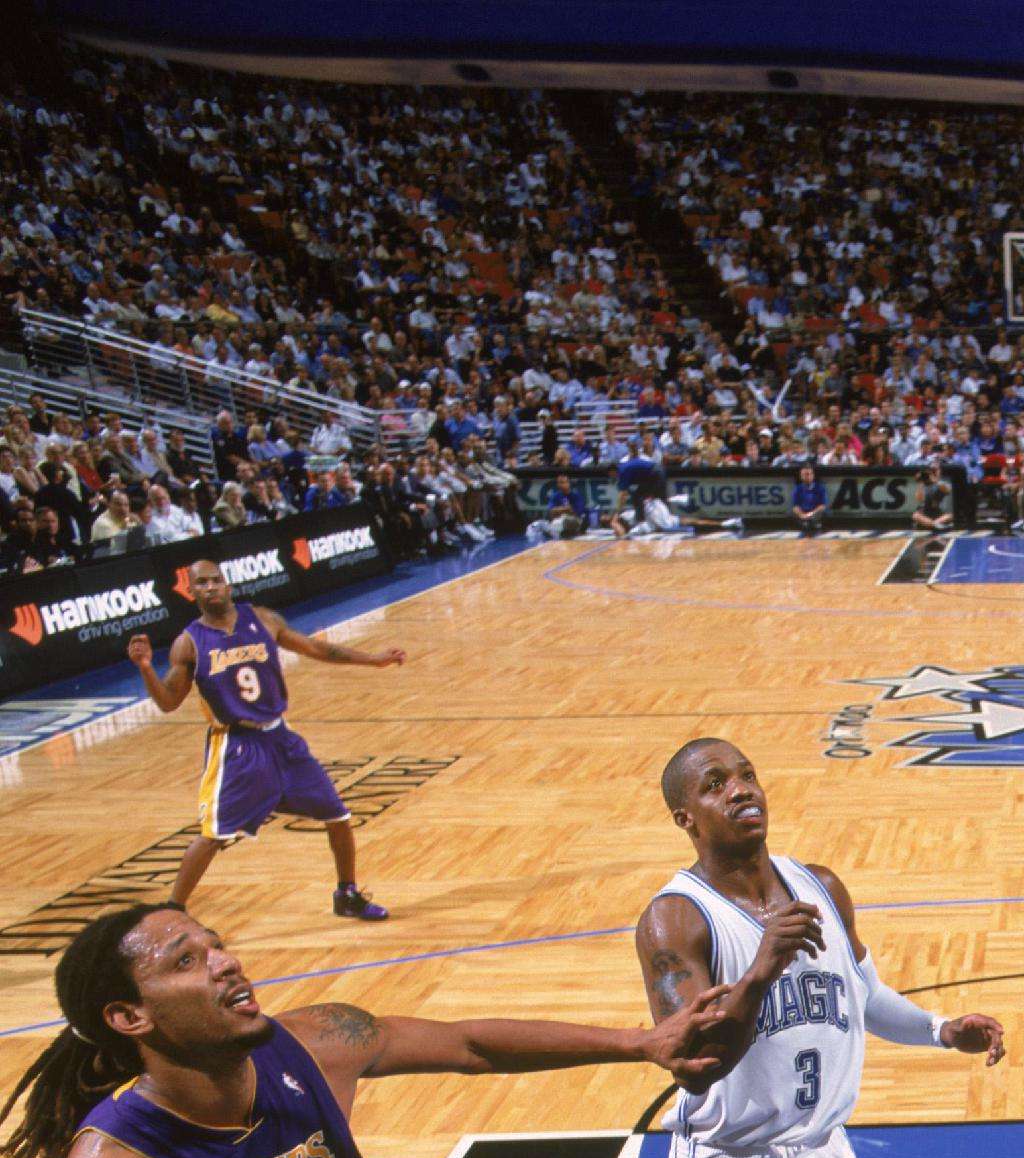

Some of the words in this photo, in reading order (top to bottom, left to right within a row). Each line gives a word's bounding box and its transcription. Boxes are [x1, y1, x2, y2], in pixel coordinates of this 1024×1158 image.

[831, 478, 906, 510] ACS
[122, 607, 169, 631] emotion
[236, 666, 261, 702] 9
[795, 1048, 821, 1110] 3
